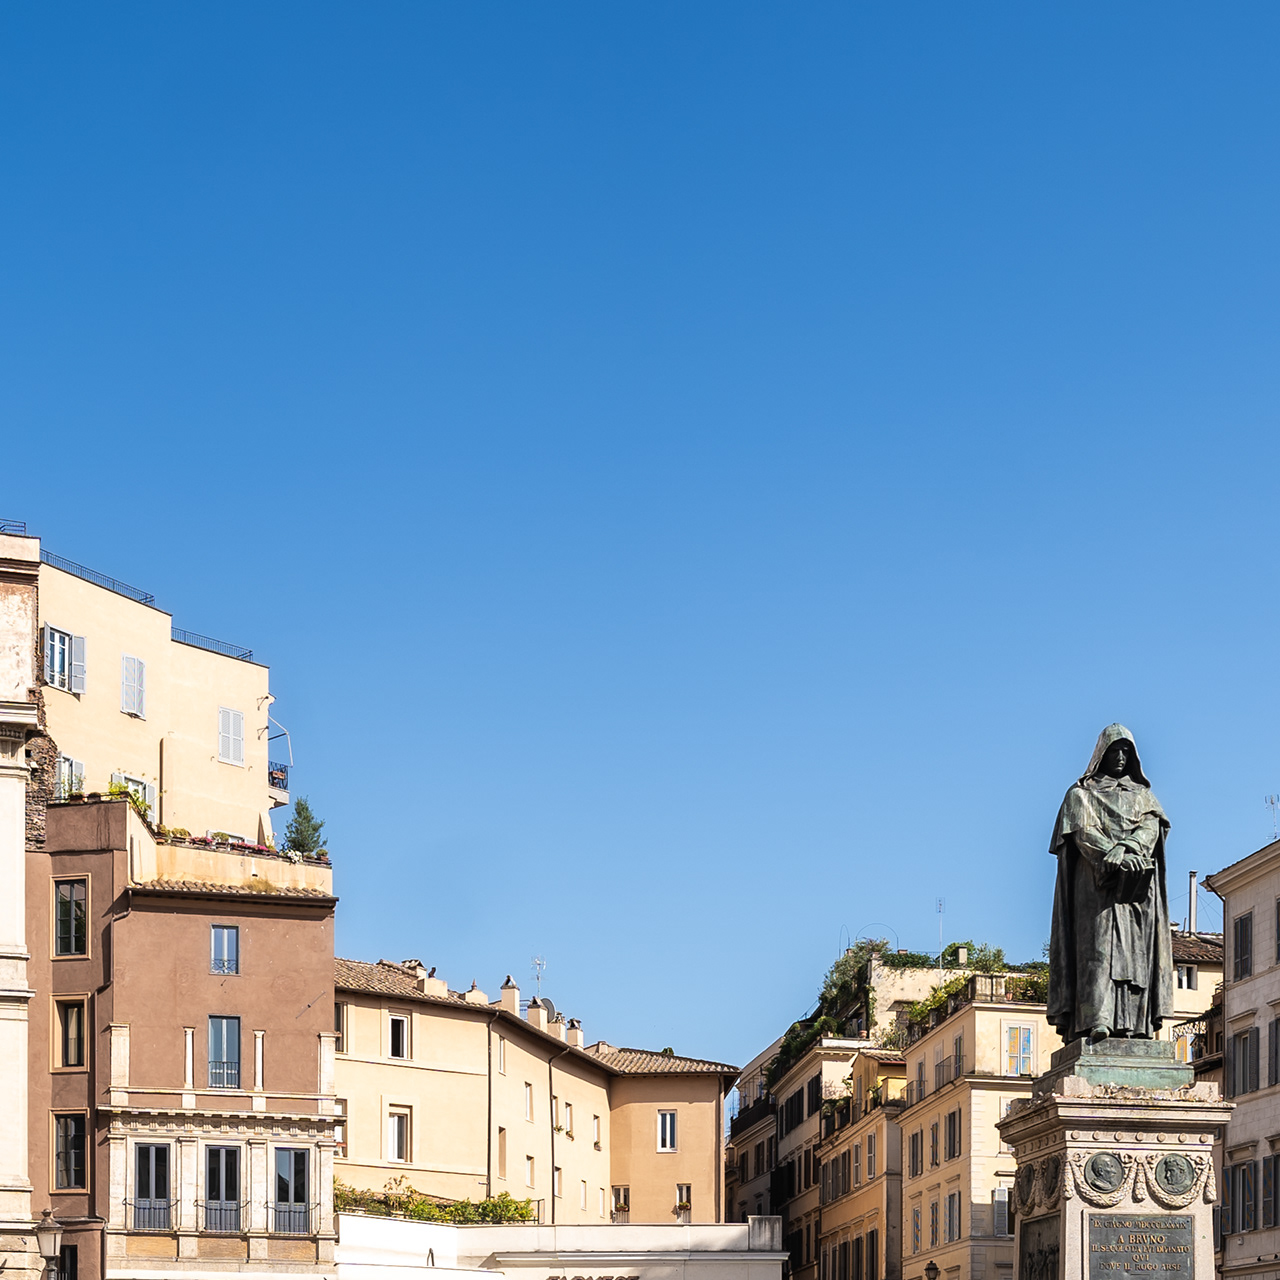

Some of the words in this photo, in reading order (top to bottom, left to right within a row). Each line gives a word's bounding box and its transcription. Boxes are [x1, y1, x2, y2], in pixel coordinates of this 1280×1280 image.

[1117, 1234, 1124, 1244] A
[1128, 1234, 1166, 1244] BRVNO
[1132, 1254, 1149, 1263] QVI
[1135, 1263, 1159, 1271] ROGO
